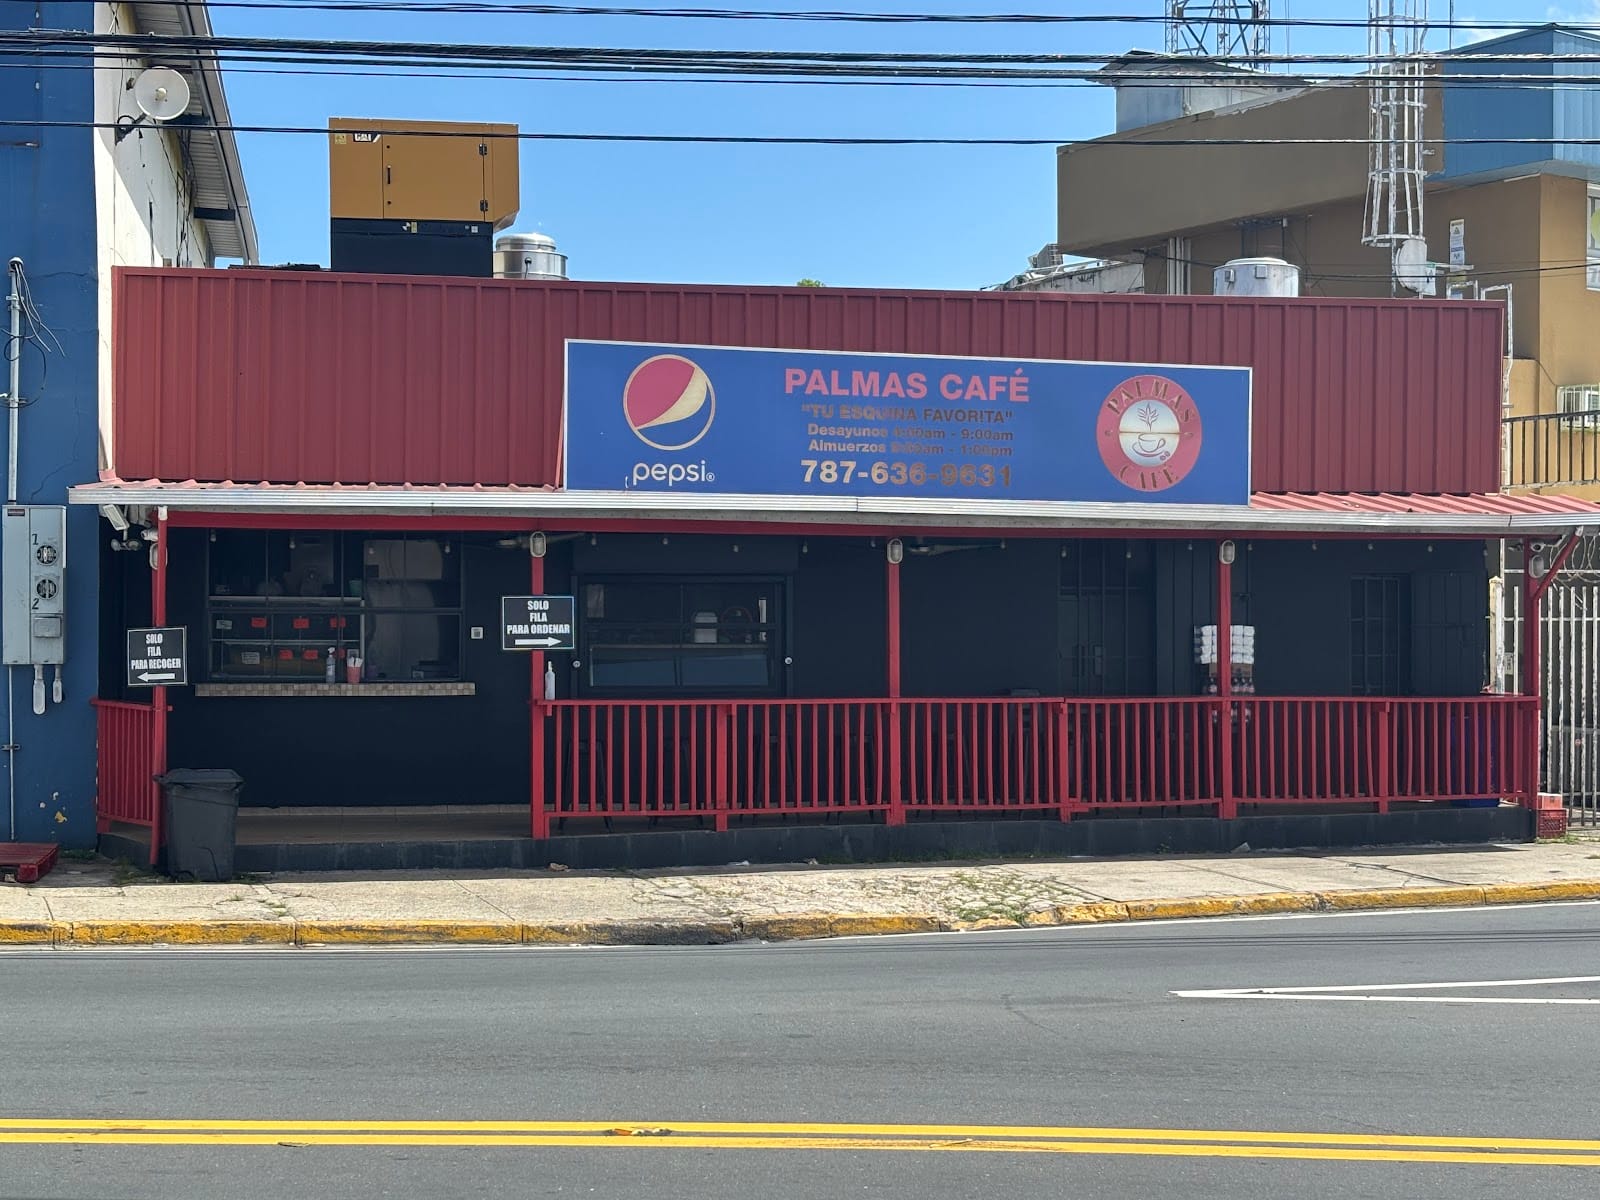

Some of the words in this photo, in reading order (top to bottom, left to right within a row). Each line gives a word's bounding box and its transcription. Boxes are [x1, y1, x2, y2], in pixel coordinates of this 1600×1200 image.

[785, 368, 928, 399] PALMAS
[939, 368, 1030, 402] CAFÉ
[802, 403, 834, 419] "TU
[839, 404, 918, 420] ESQUINA
[922, 408, 1013, 424] FAVORITA"
[807, 423, 888, 439] Desayunos
[961, 428, 1014, 441] 9:00am
[808, 439, 886, 453] Almuerzos
[800, 459, 1012, 488] 787-636-9631
[31, 597, 40, 610] 2
[527, 600, 549, 611] SOLO
[529, 612, 548, 623] FILA
[506, 624, 530, 635] PARA
[530, 624, 570, 634] ORDENAR
[145, 633, 163, 645] SOLO
[147, 646, 162, 657] FILA
[131, 659, 149, 670] PARA
[148, 657, 181, 669] RECOGER
